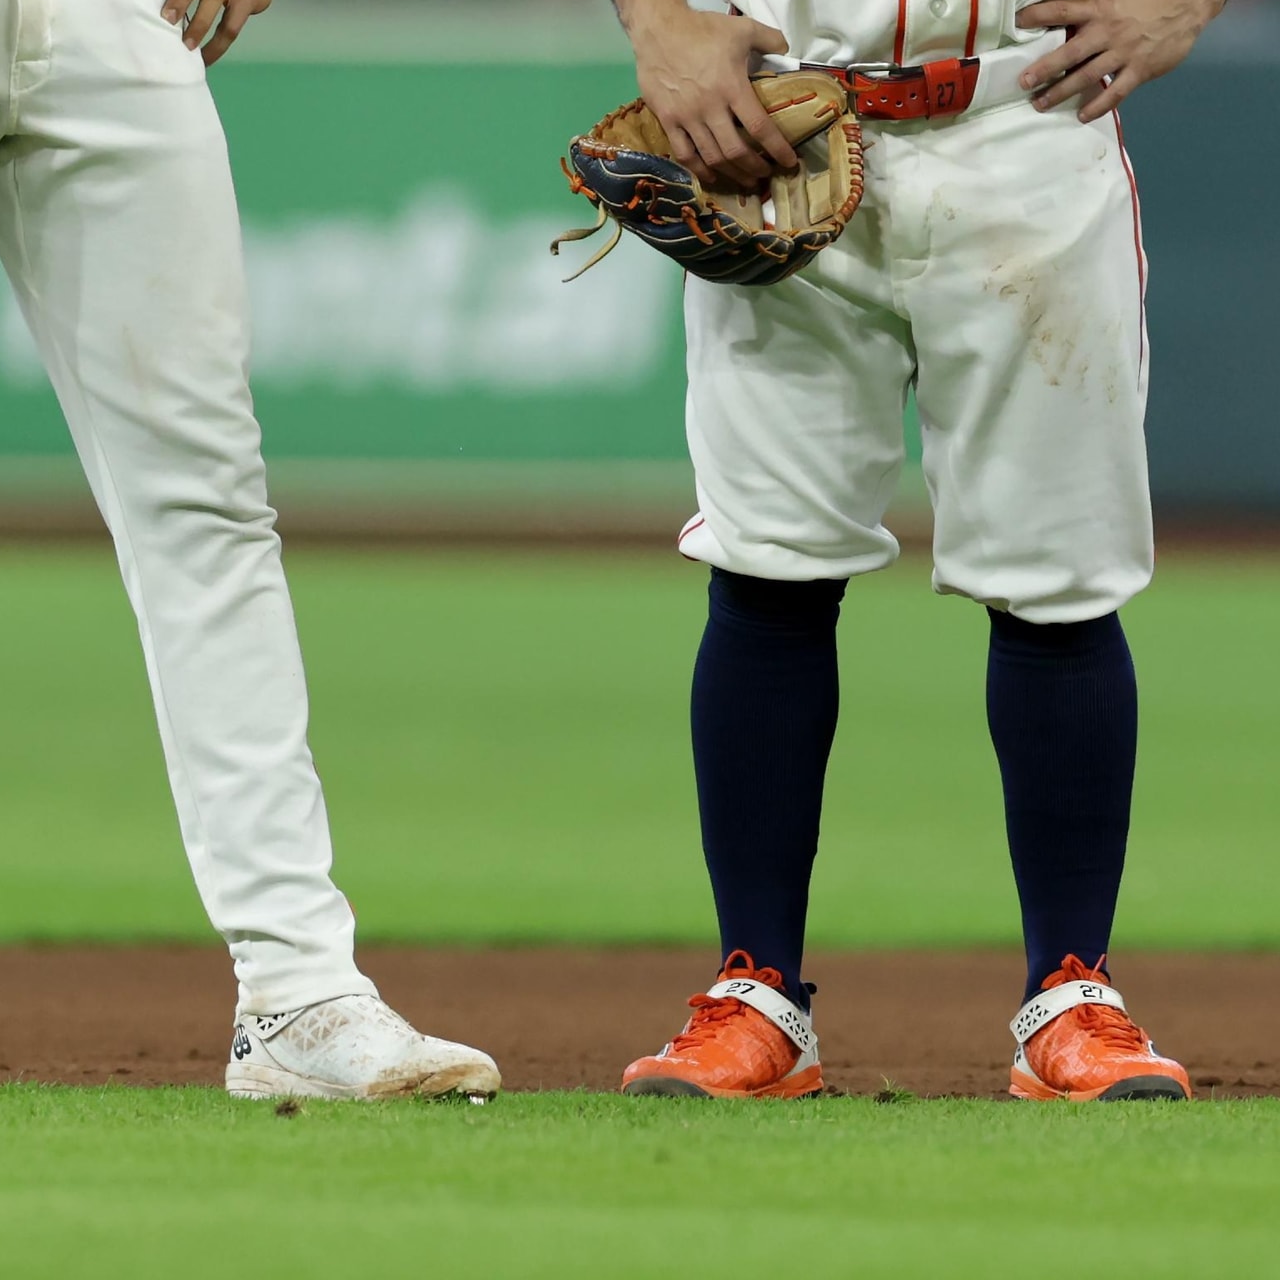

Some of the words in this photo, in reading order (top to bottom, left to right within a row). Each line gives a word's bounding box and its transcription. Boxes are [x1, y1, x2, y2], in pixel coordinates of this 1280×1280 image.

[936, 81, 956, 107] 27
[725, 981, 756, 994] 27
[1080, 984, 1103, 999] 27
